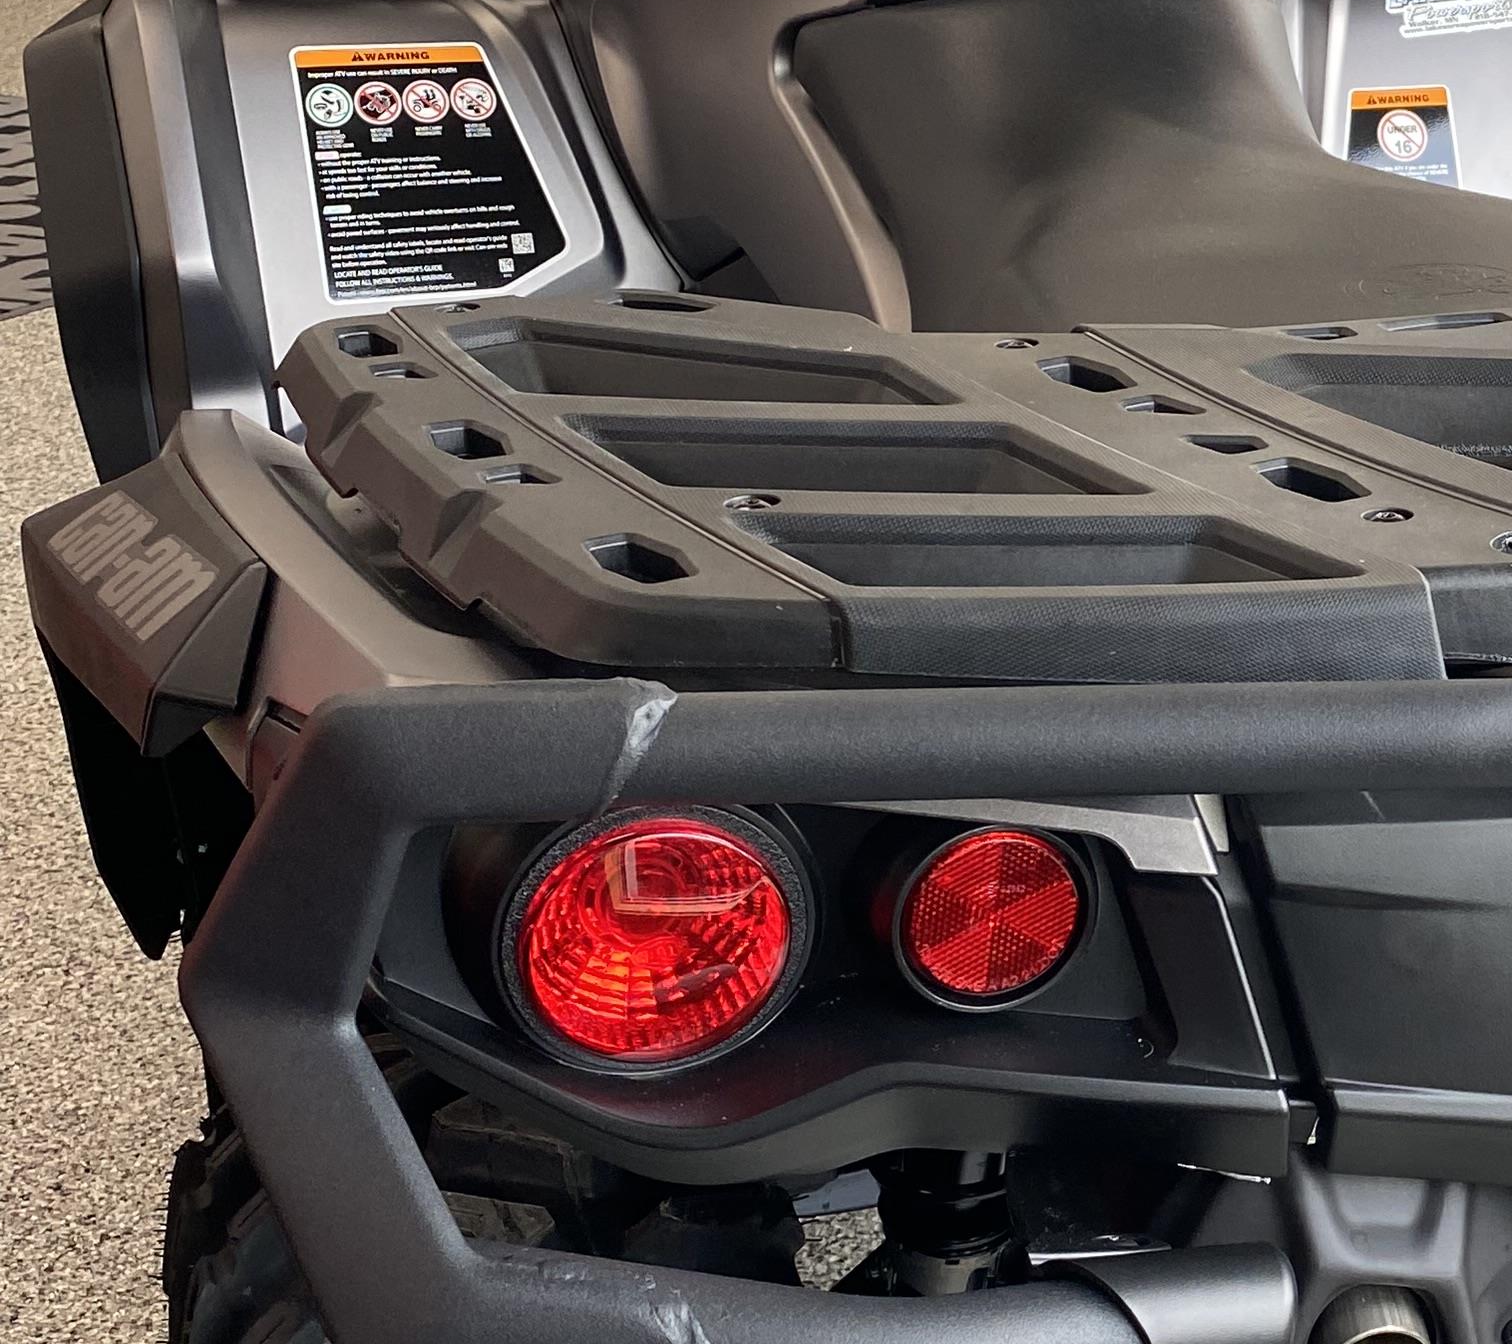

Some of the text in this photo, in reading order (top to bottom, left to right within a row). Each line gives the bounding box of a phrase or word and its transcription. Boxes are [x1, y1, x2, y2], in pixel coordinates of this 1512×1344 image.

[364, 51, 430, 61] WARNING
[1379, 95, 1429, 104] WARNING
[1387, 125, 1417, 134] UNDER
[1395, 140, 1412, 153] 16
[334, 270, 356, 279] LOCATE
[372, 268, 388, 276] READ
[424, 264, 443, 272] GUIDE
